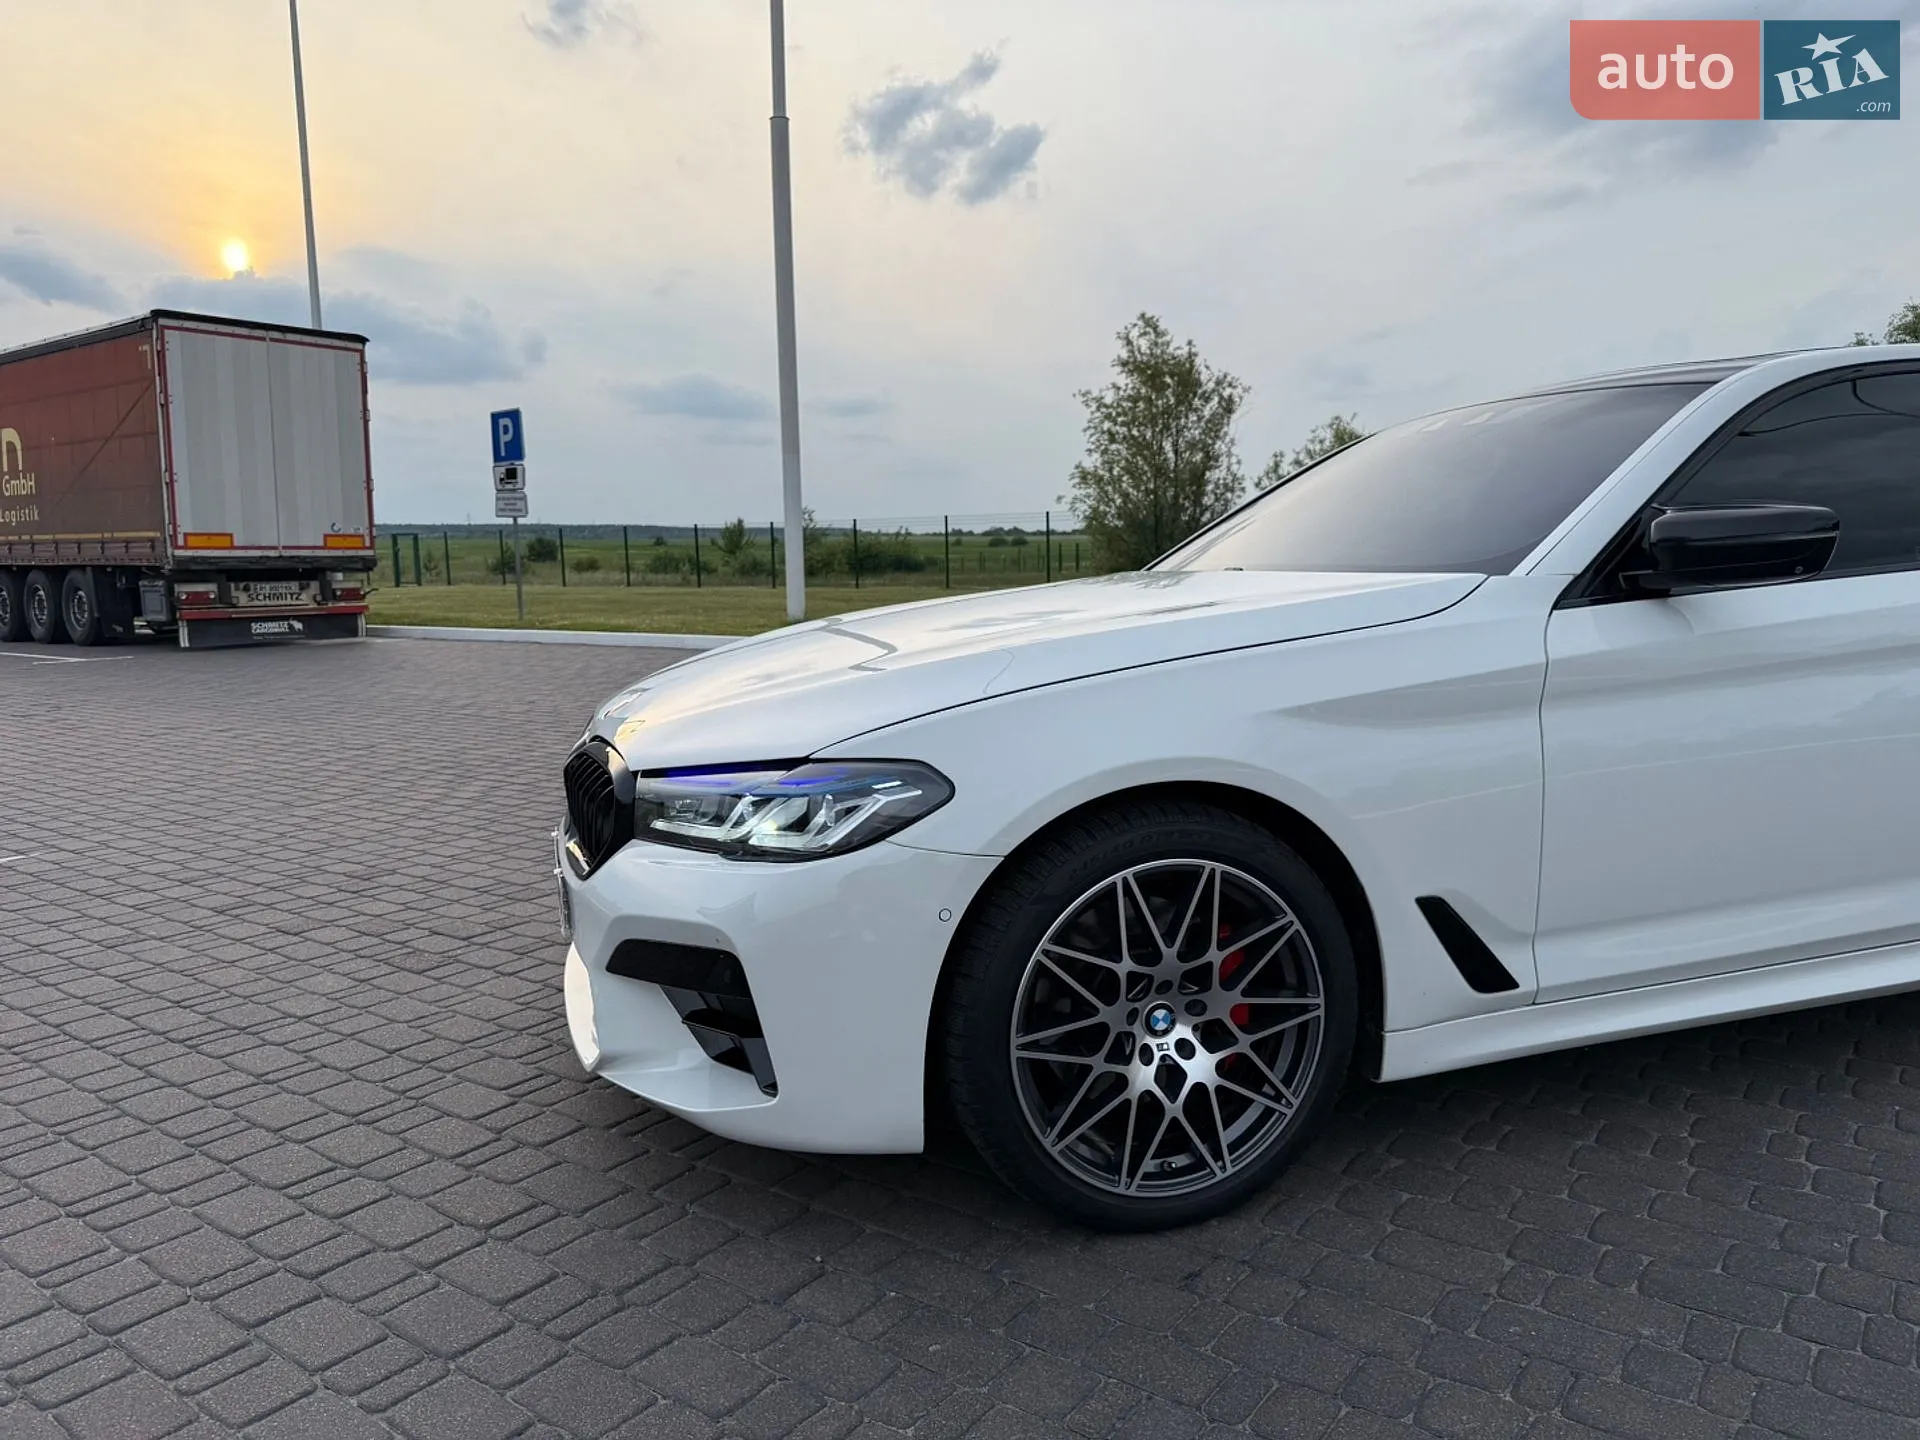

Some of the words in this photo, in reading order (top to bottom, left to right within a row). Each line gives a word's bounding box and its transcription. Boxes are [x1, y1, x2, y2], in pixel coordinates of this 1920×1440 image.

[498, 417, 514, 457] P
[2, 472, 36, 496] GmbH
[0, 503, 39, 526] Logistik
[247, 592, 304, 602] SCHMITZ
